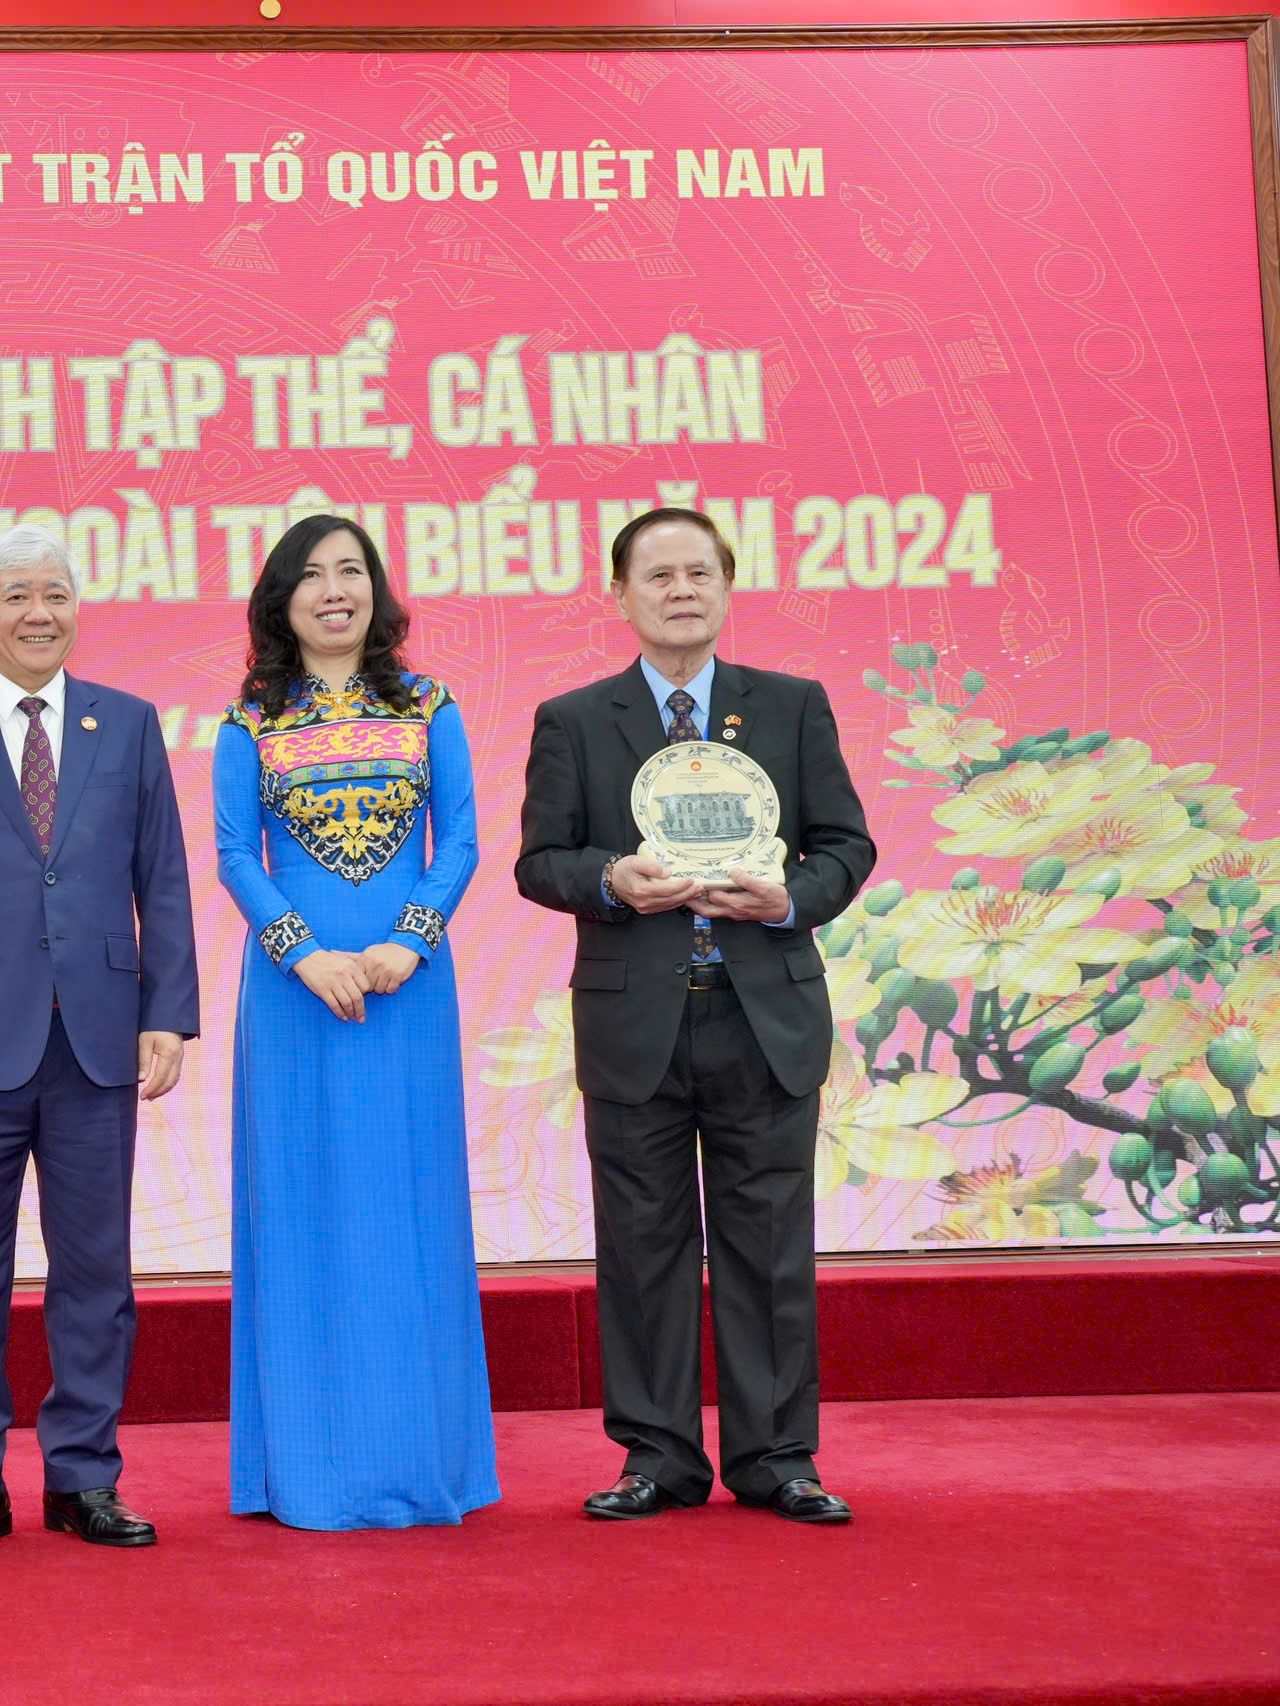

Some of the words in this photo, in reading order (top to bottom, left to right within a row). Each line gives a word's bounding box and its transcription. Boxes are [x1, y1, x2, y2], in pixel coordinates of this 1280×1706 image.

[32, 141, 205, 215] TRẬN
[225, 131, 306, 203] TỔ
[327, 132, 499, 209] QUỐC
[519, 139, 655, 212] VIỆT
[676, 147, 825, 199] NAM
[68, 339, 226, 469] TẬP
[236, 317, 413, 459] THỂ,
[428, 334, 538, 447] CÁ
[548, 333, 766, 446] NHÂN
[404, 464, 583, 598] BIỂU
[793, 493, 1002, 590] 2024
